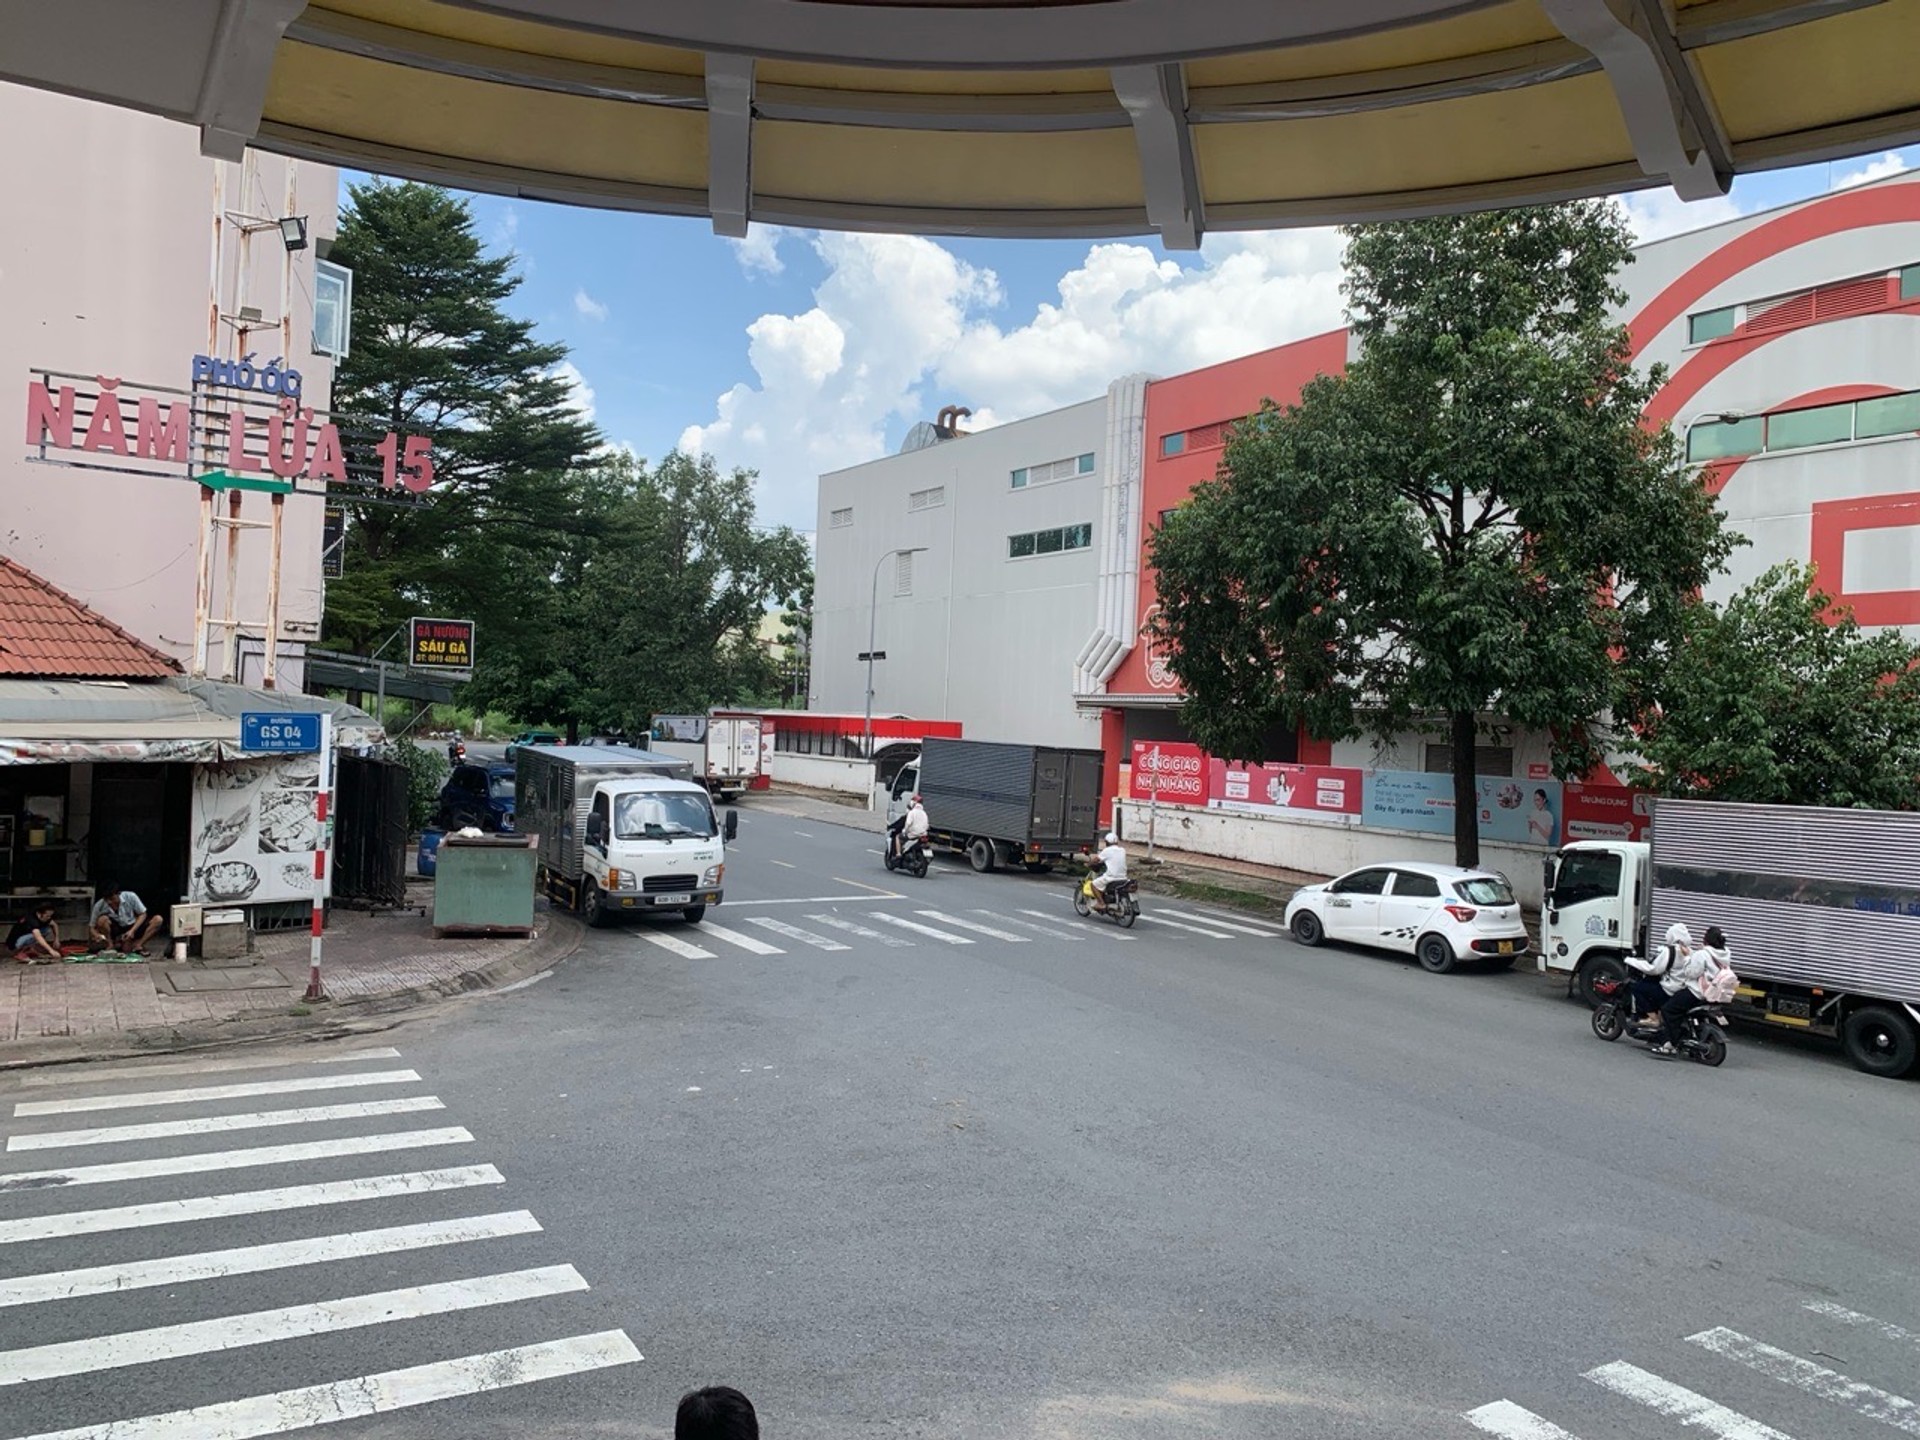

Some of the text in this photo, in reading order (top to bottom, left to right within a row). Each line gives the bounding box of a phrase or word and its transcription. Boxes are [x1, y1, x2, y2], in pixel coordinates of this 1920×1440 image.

[193, 353, 302, 397] PHỐ ỐC
[26, 375, 433, 493] NĂM LỬA 15
[419, 639, 467, 654] SÁU GÀ
[261, 726, 302, 738] GS 04
[1172, 756, 1200, 773] GIAO
[1169, 775, 1201, 794] HÀNG
